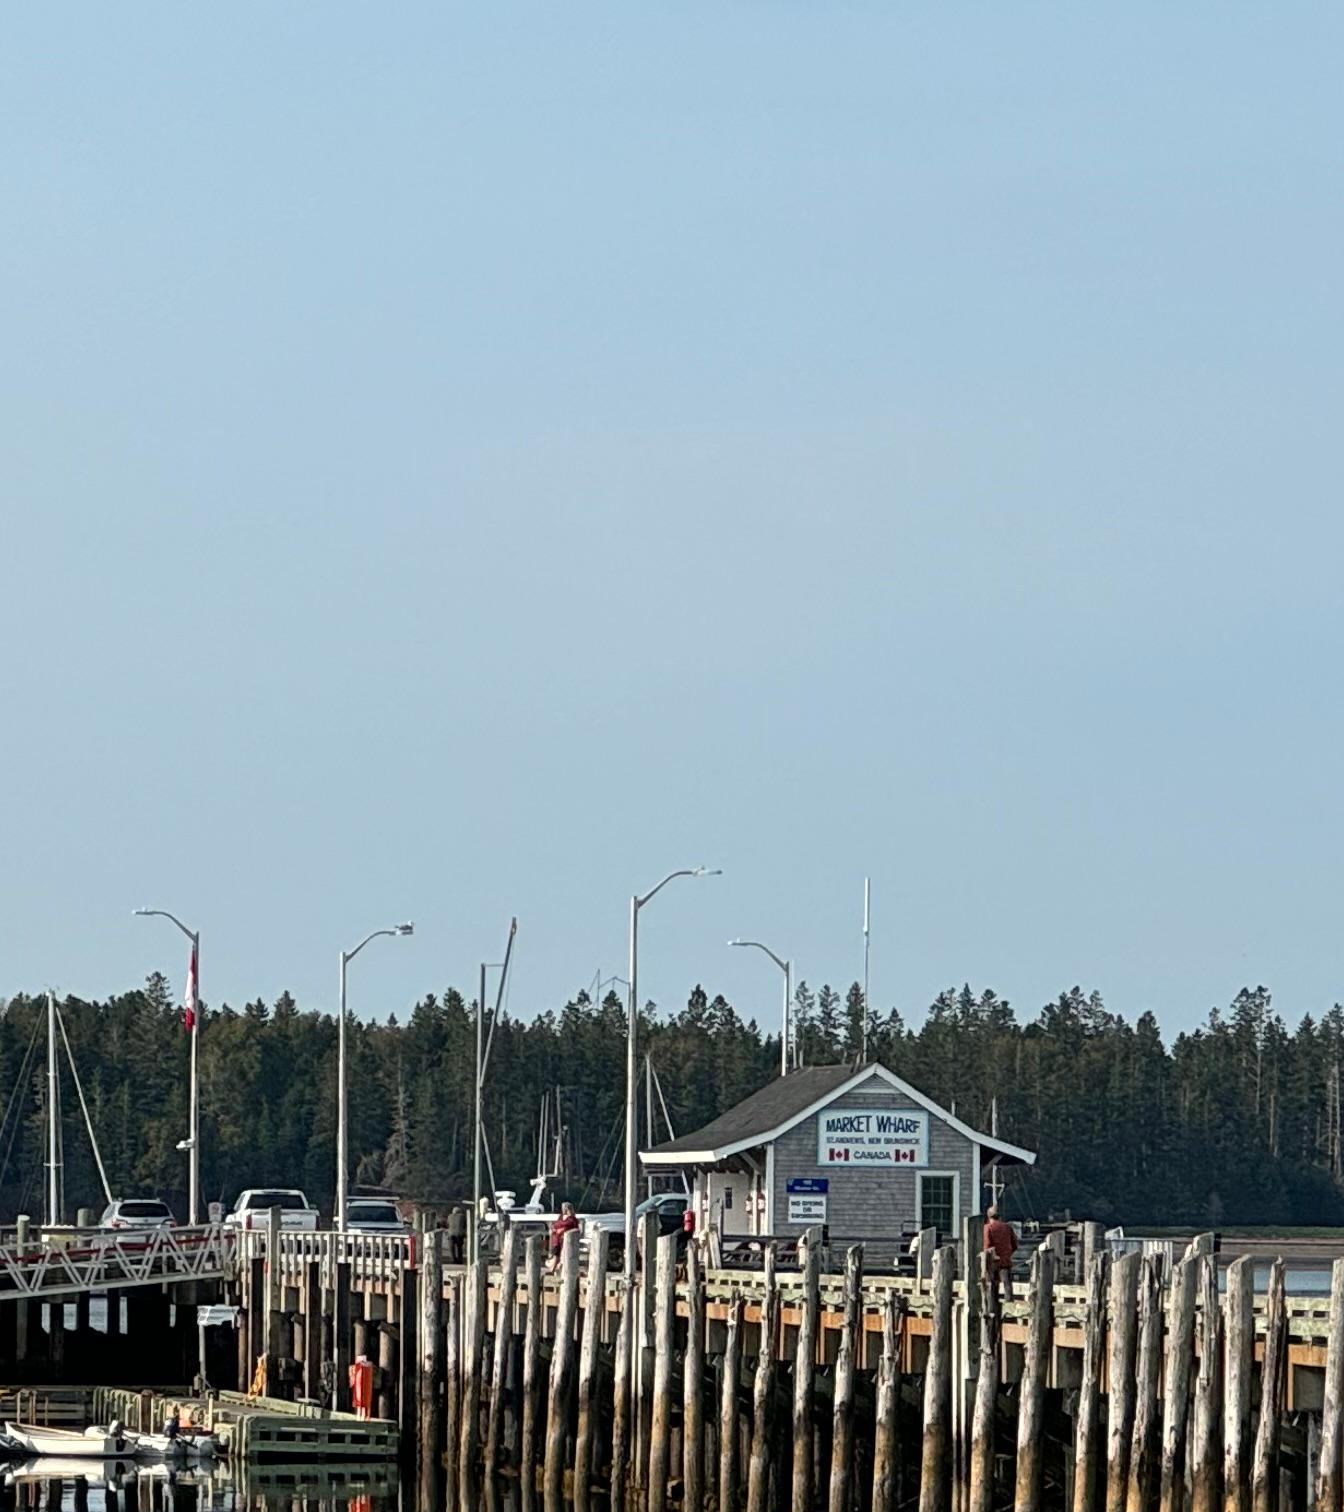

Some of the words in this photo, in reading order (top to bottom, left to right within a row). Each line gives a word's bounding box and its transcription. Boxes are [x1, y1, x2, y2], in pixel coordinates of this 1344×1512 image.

[826, 1115, 872, 1133] MARKET
[876, 1115, 921, 1133] WHARF
[853, 1150, 892, 1160] CANADA
